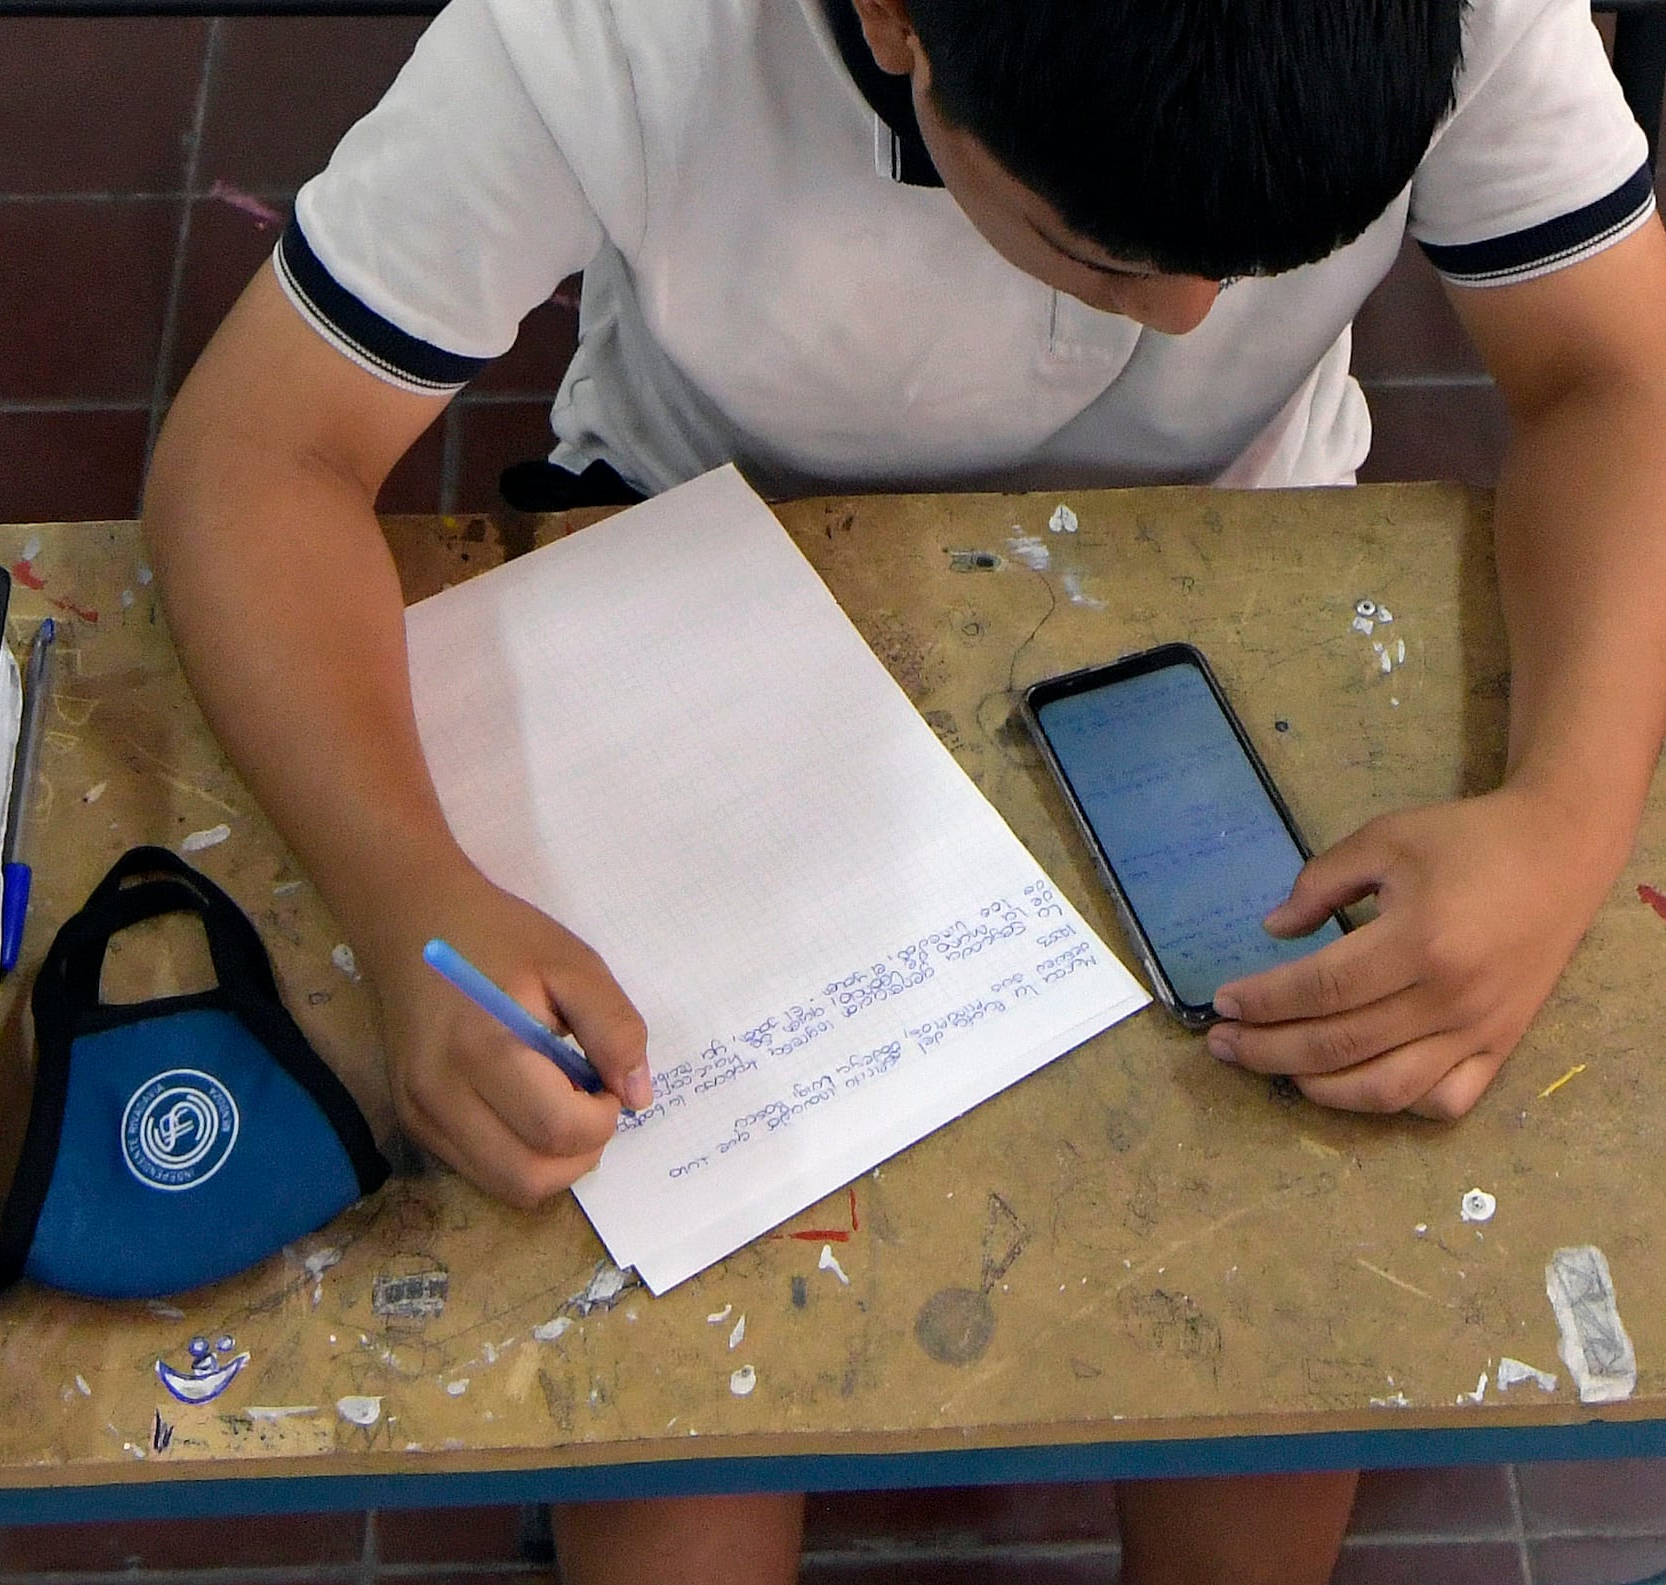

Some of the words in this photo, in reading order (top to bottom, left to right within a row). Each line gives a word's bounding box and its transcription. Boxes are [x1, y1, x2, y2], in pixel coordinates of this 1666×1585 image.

[1022, 879, 1044, 896] de
[1030, 889, 1053, 907] de
[979, 898, 1012, 918] los
[1000, 906, 1027, 927] la
[935, 923, 988, 953] mano
[902, 948, 929, 970] de
[1013, 983, 1039, 998] la
[781, 1006, 825, 1032] quien
[783, 1004, 807, 1023] El
[700, 1038, 727, 1060] ya
[917, 1030, 944, 1055] del
[667, 1093, 686, 1106] la
[716, 1129, 750, 1154] que
